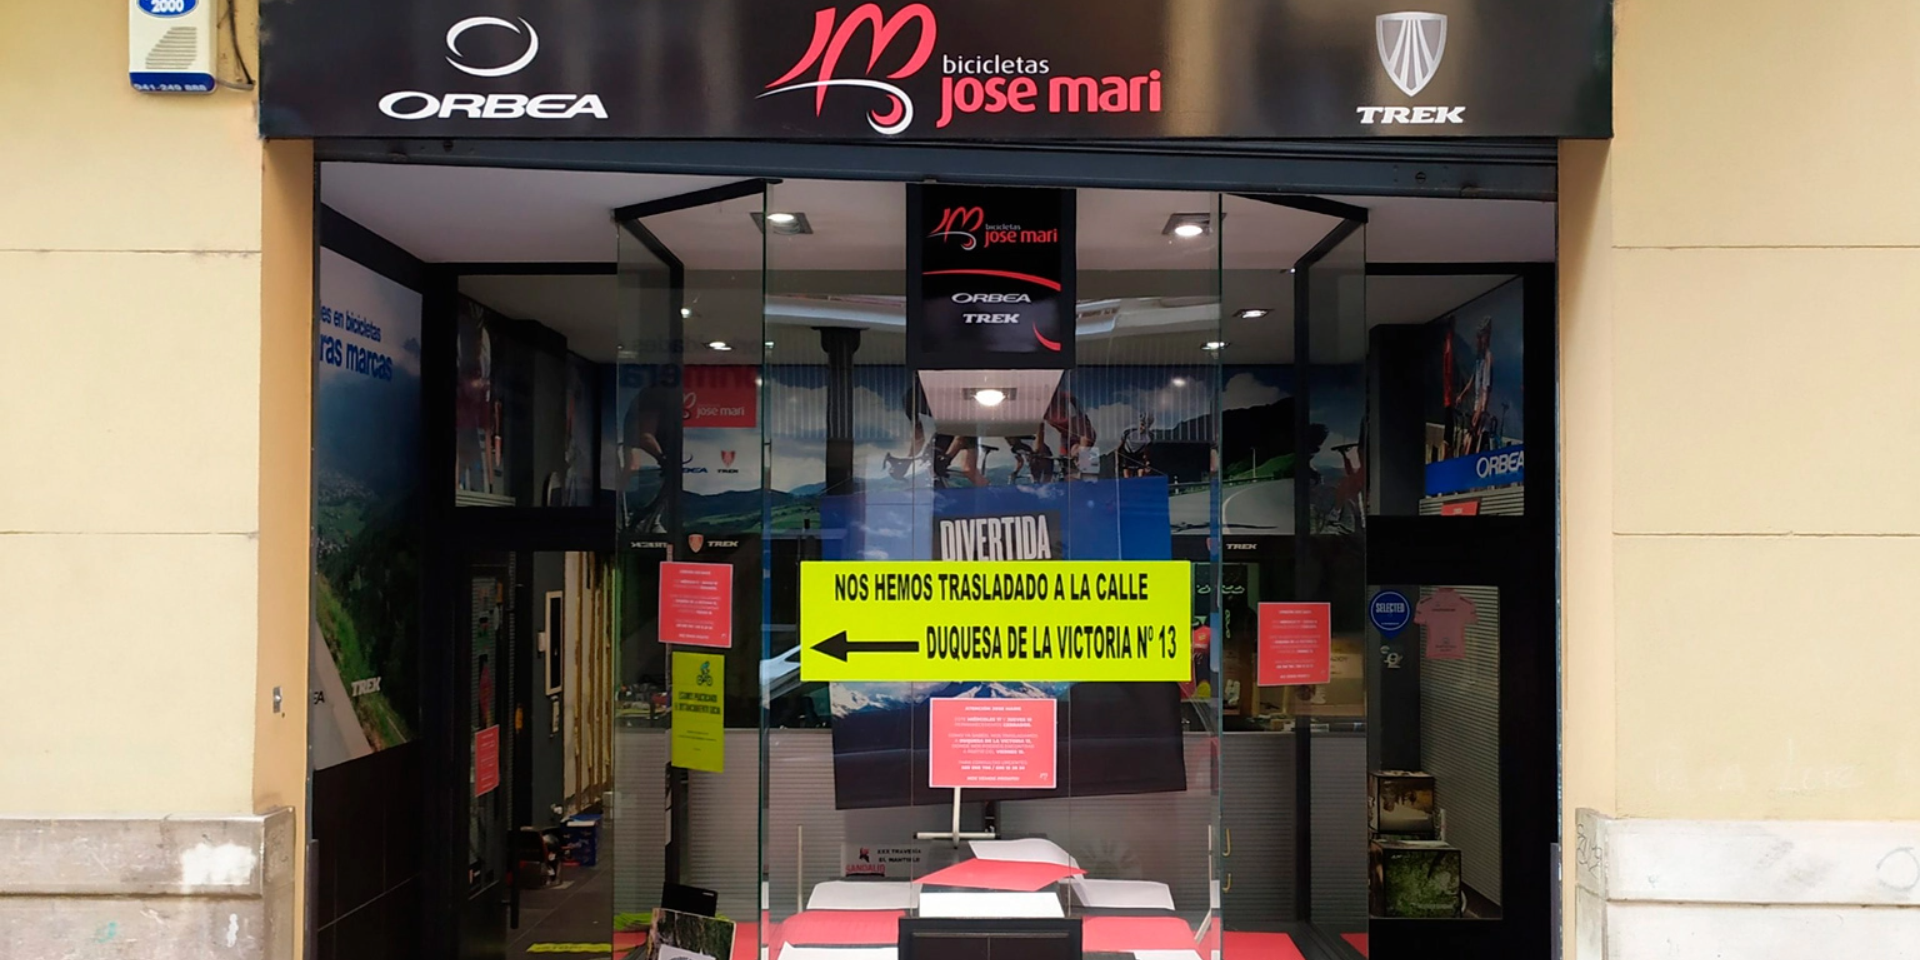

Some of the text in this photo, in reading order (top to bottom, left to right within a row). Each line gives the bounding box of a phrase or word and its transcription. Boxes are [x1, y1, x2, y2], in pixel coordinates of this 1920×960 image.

[151, 0, 184, 12] 2000
[943, 55, 1049, 74] bicicletas
[378, 91, 609, 119] ORBEA
[936, 69, 1161, 128] jose mari
[1356, 106, 1466, 123] TREK
[984, 229, 1058, 248] jose mari
[951, 293, 1031, 304] ORBEA
[334, 310, 344, 328] en
[345, 310, 381, 343] bicicletas
[963, 314, 1020, 323] TREK
[346, 343, 393, 382] marcas
[697, 405, 745, 418] jose mari
[940, 515, 1051, 561] DIVERTIDA
[835, 573, 1148, 601] NOS HEMOS TRASLADADO A LA CALLE
[1375, 602, 1405, 613] SELECTED
[926, 626, 1001, 661] DUQUESA
[1008, 626, 1028, 659] DE
[1032, 625, 1052, 659] LA
[1057, 624, 1132, 659] VICTORIA
[1158, 624, 1176, 658] 13
[351, 677, 381, 697] TREK
